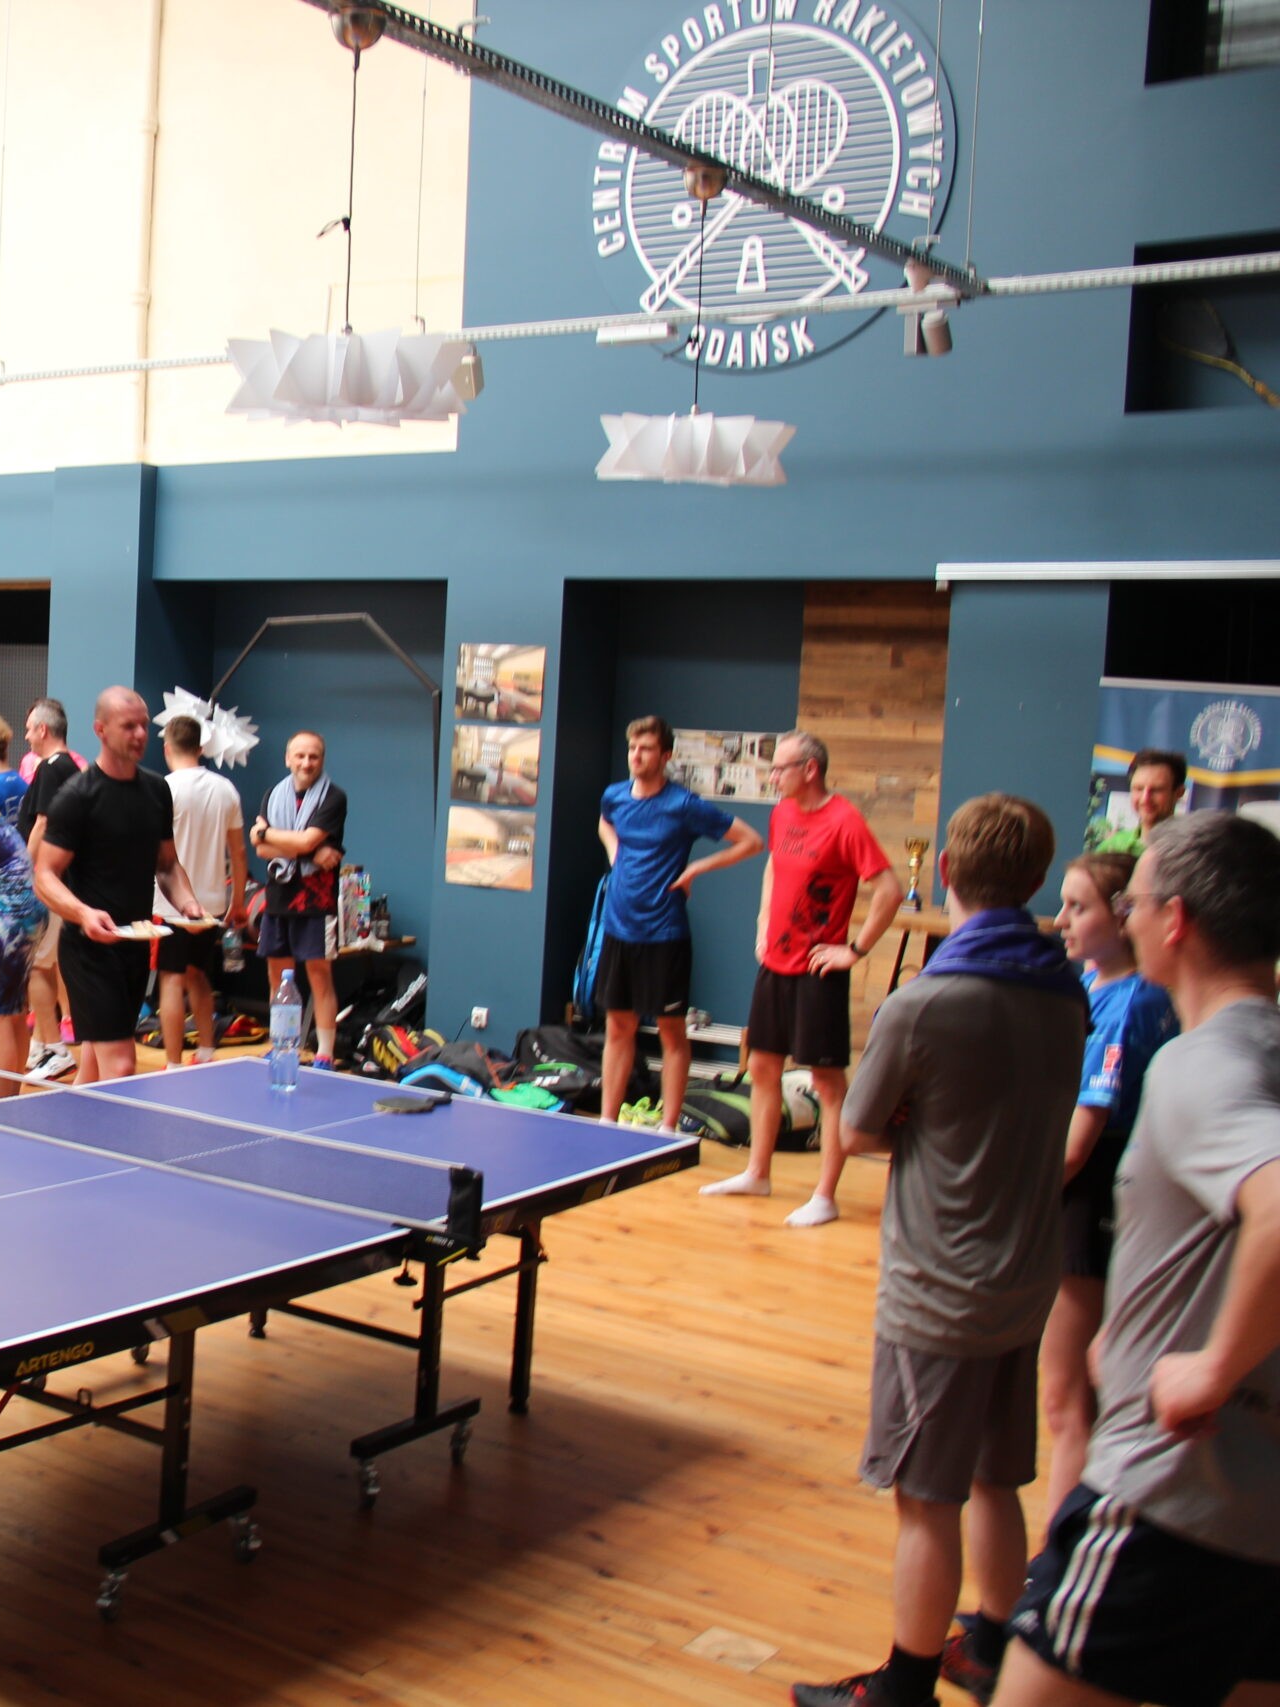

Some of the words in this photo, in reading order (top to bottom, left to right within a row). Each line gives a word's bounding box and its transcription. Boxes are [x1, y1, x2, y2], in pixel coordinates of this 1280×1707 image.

[592, 86, 649, 258] CENTRM
[813, 0, 944, 219] RAKIETOWYCH
[685, 316, 815, 368] GDAŃSK
[16, 1341, 95, 1377] ARTENGO
